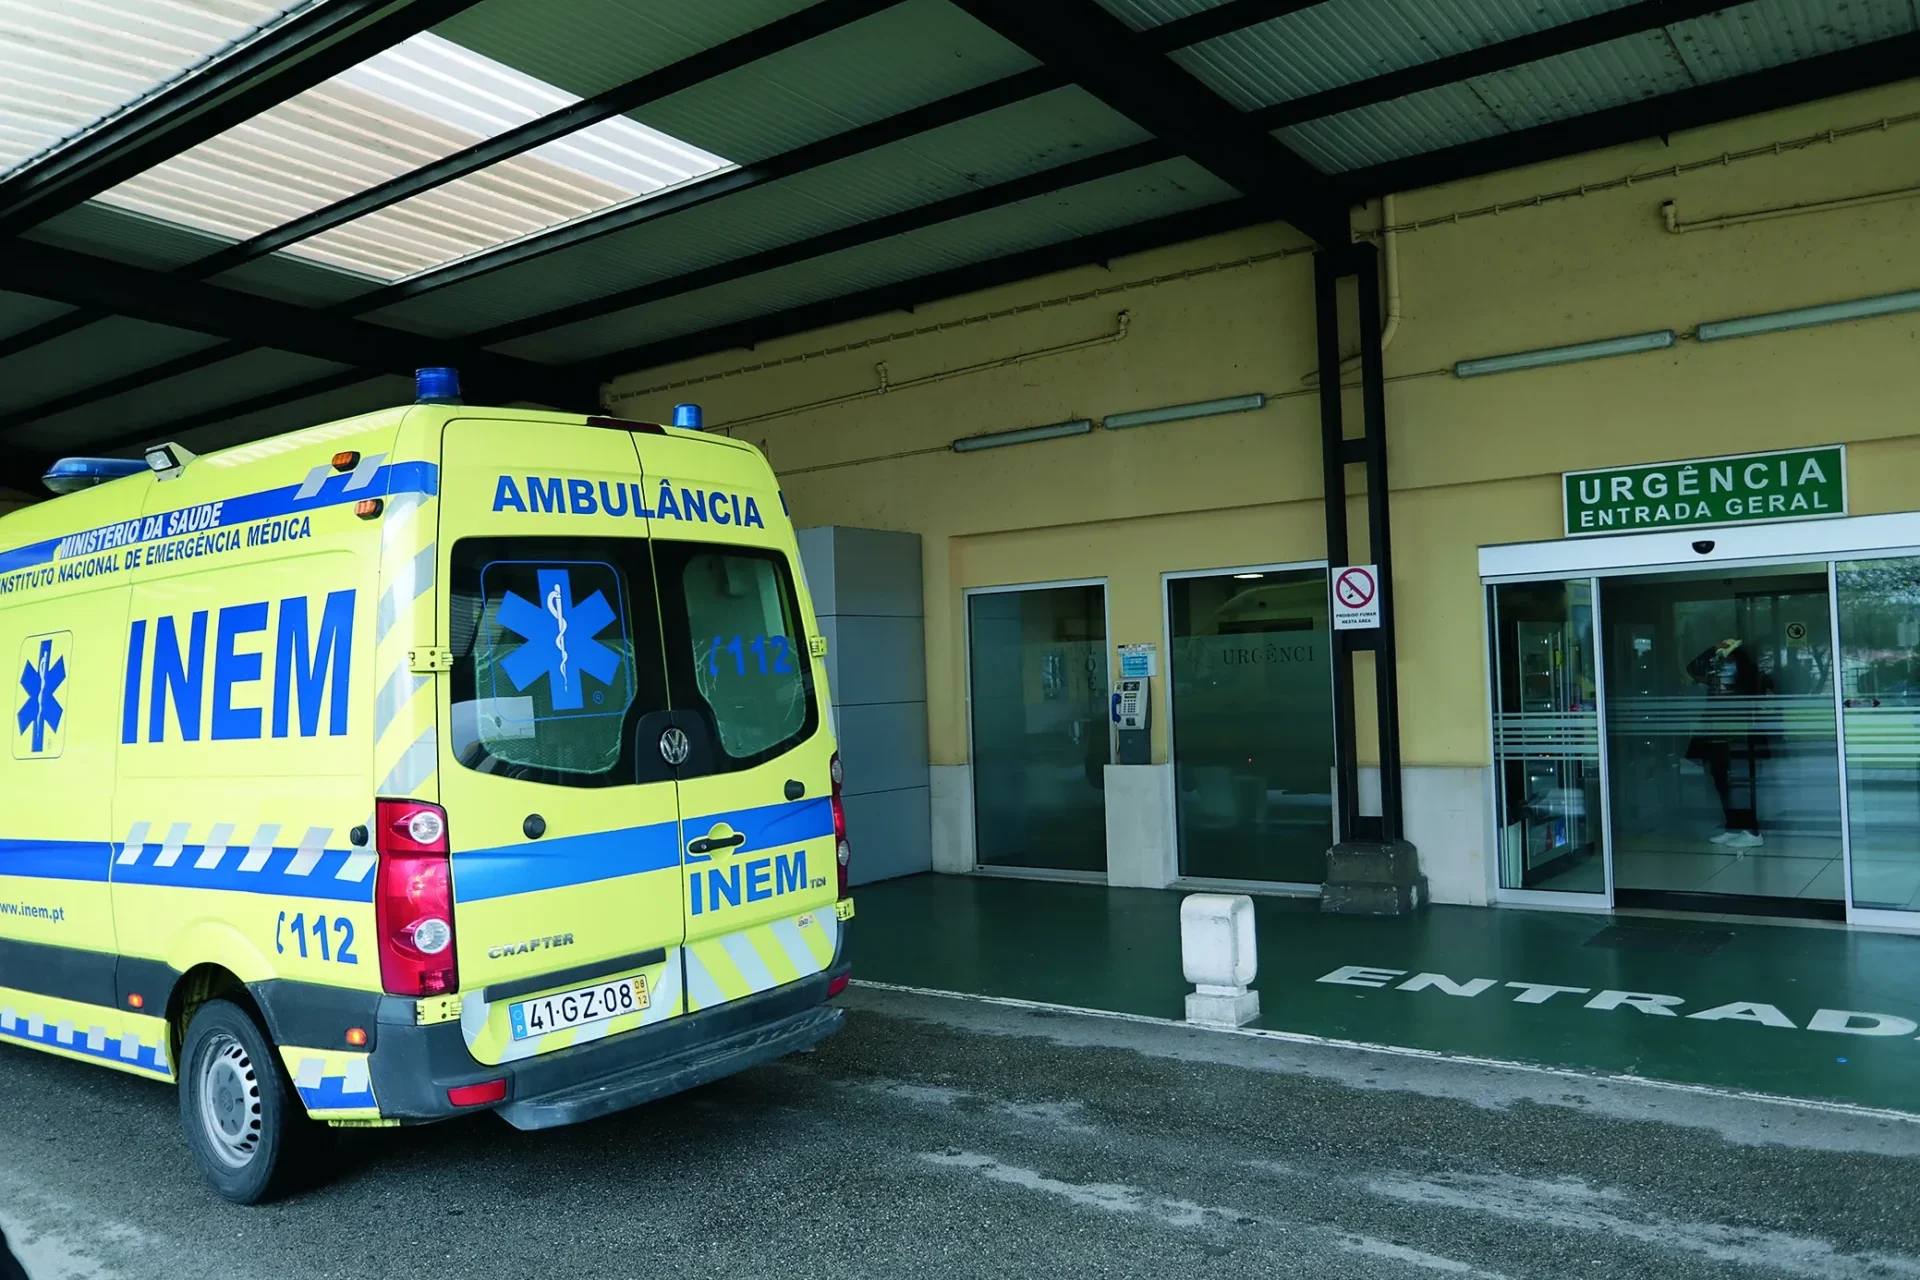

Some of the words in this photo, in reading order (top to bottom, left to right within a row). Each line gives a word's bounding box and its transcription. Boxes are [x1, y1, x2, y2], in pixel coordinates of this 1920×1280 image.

[492, 474, 765, 529] AMBULÂNCIA
[1579, 456, 1827, 505] URGÊNCIA
[142, 514, 163, 540] DA
[1580, 501, 1712, 528] ENTRADA
[1725, 490, 1828, 515] GERAL
[0, 567, 55, 595] NSTITUTO
[58, 553, 119, 584] NACIONAL
[125, 548, 143, 571] DE
[145, 529, 241, 566] EMERGÊNCIA
[247, 515, 311, 547] MÉDICA
[121, 588, 357, 744] INEM
[727, 634, 792, 676] 112
[690, 850, 807, 916] INEM
[810, 876, 826, 889] TDI
[290, 911, 358, 965] 112
[487, 932, 575, 959] CRAFTER
[634, 979, 646, 989] 08
[637, 994, 648, 1005] 12
[1315, 965, 1920, 1041] ENTRAD
[516, 1024, 524, 1034] P
